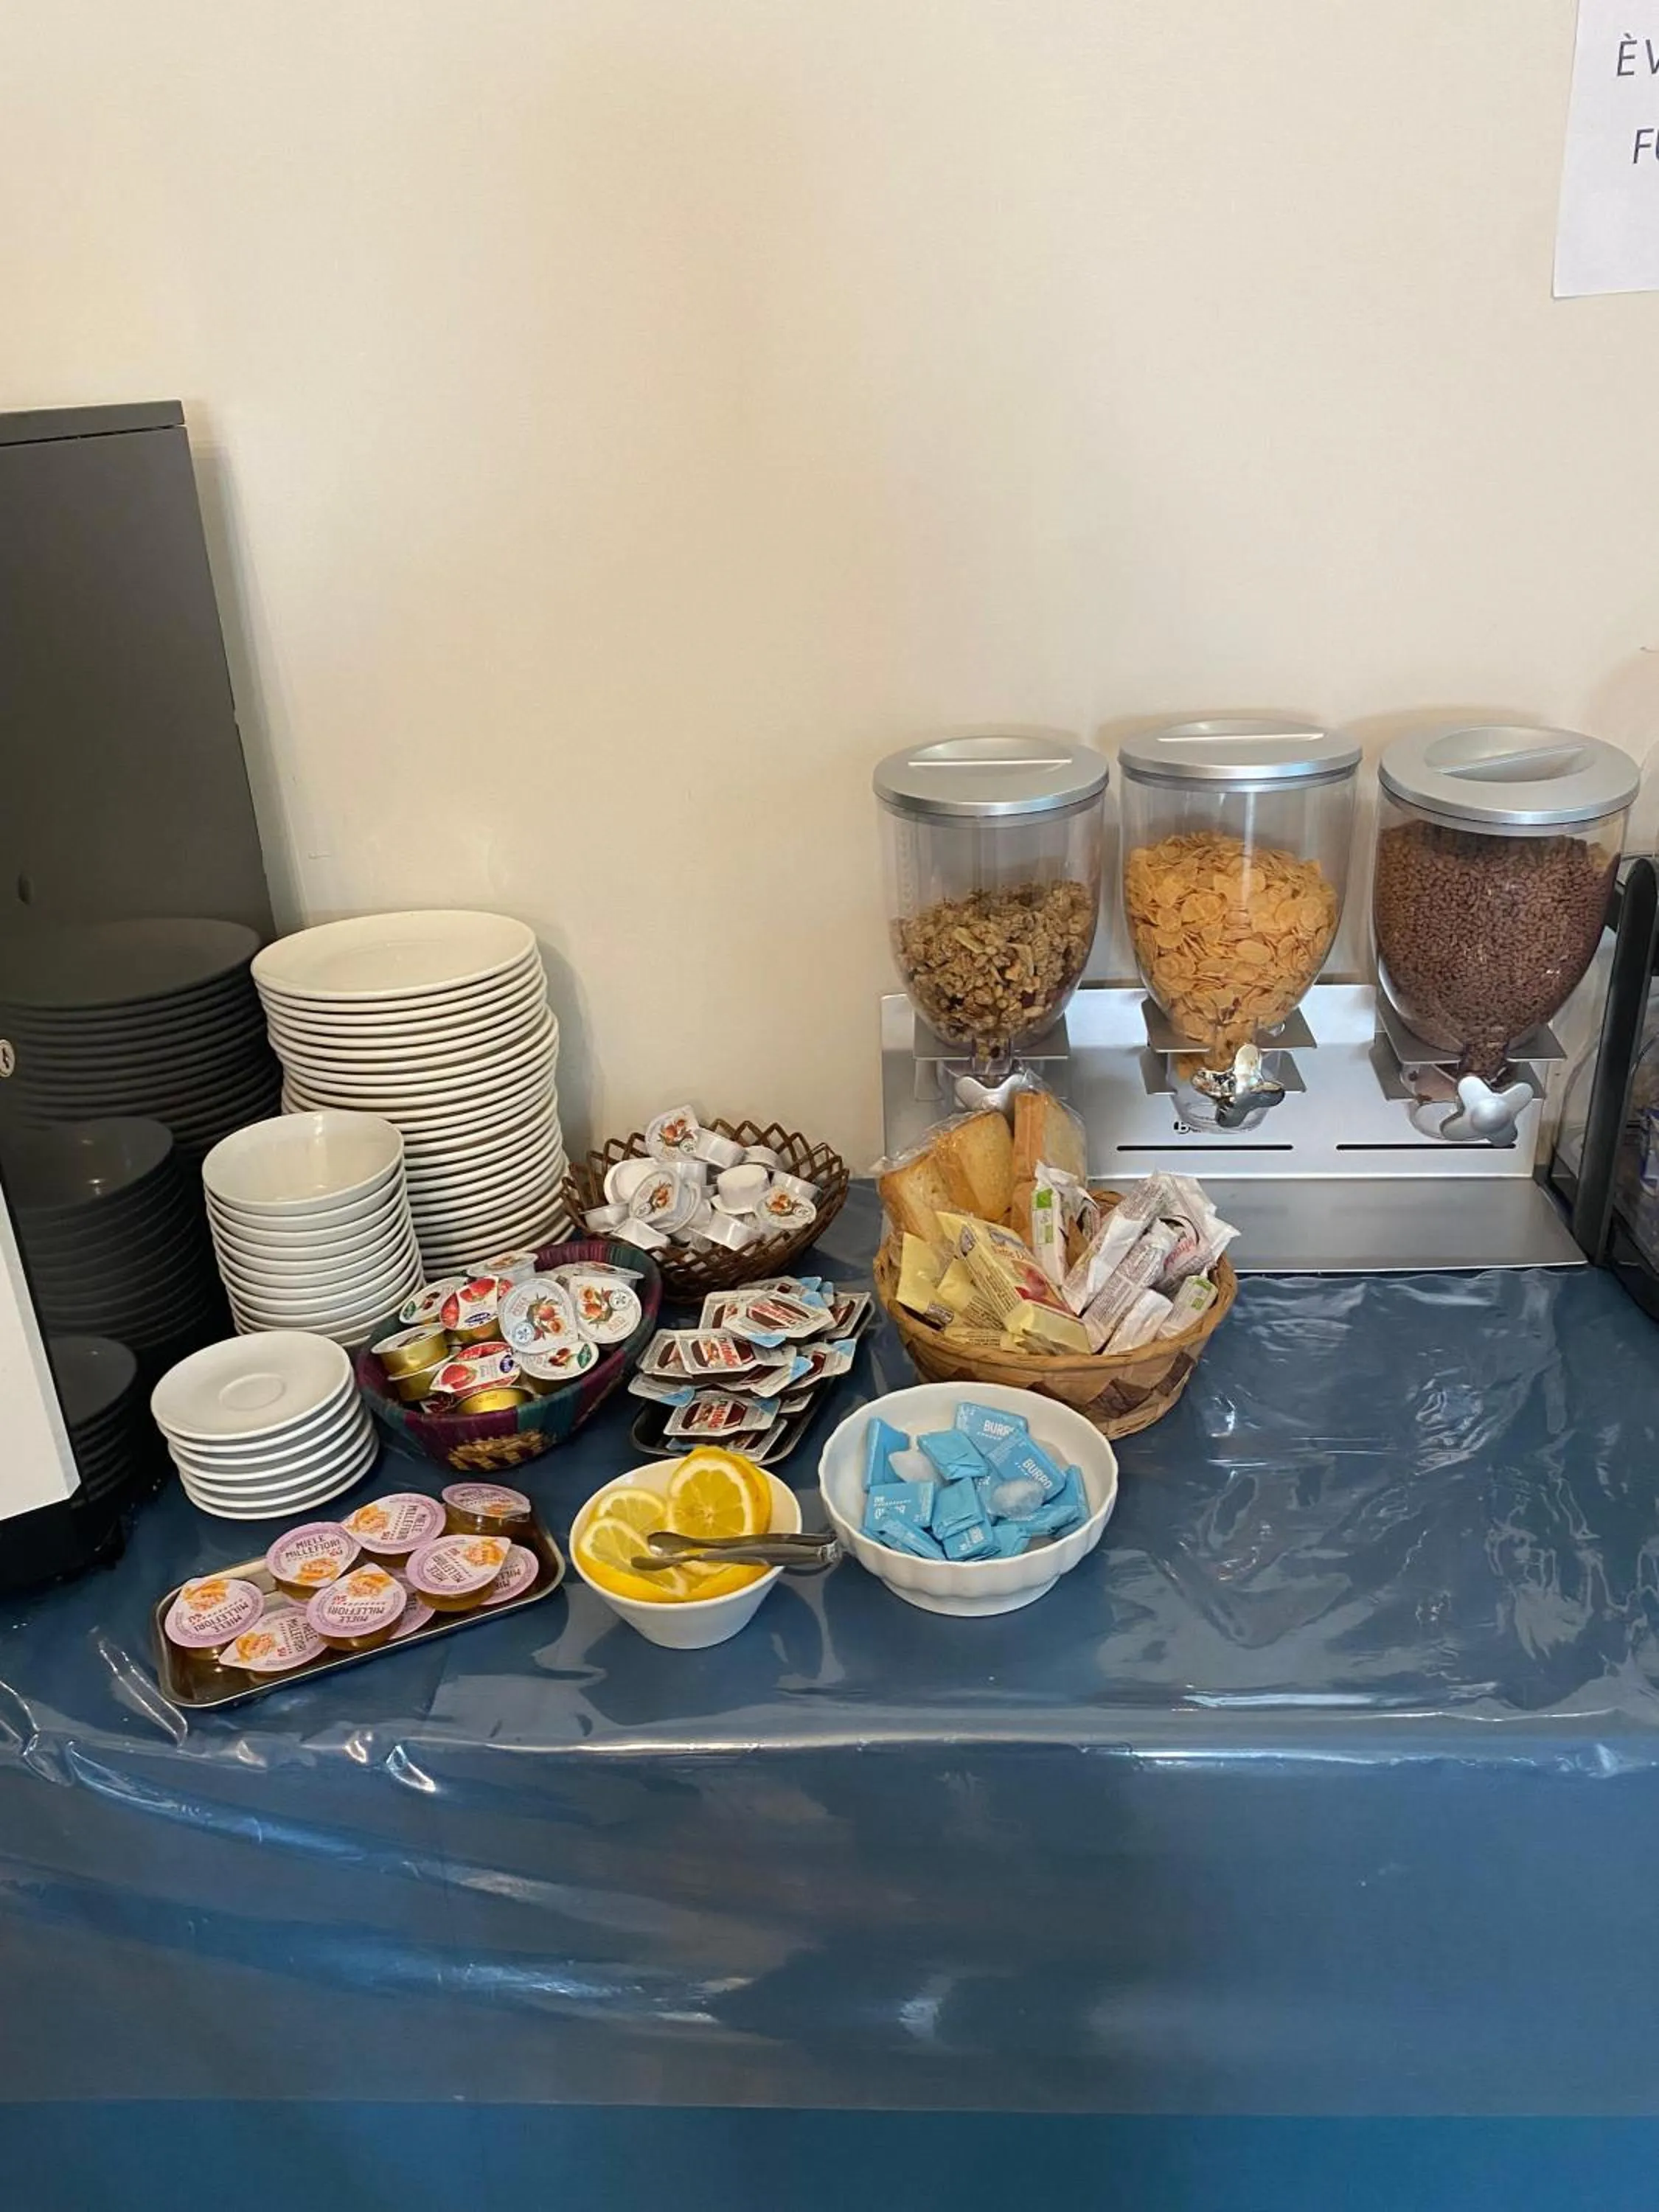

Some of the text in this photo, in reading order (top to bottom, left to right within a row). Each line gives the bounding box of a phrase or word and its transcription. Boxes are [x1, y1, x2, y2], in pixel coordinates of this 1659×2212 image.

[1632, 128, 1659, 164] F
[285, 1539, 341, 1558] MILLEFIORI
[193, 1601, 249, 1632] MILLEFIORI
[327, 1607, 385, 1615] MILLEFIORI
